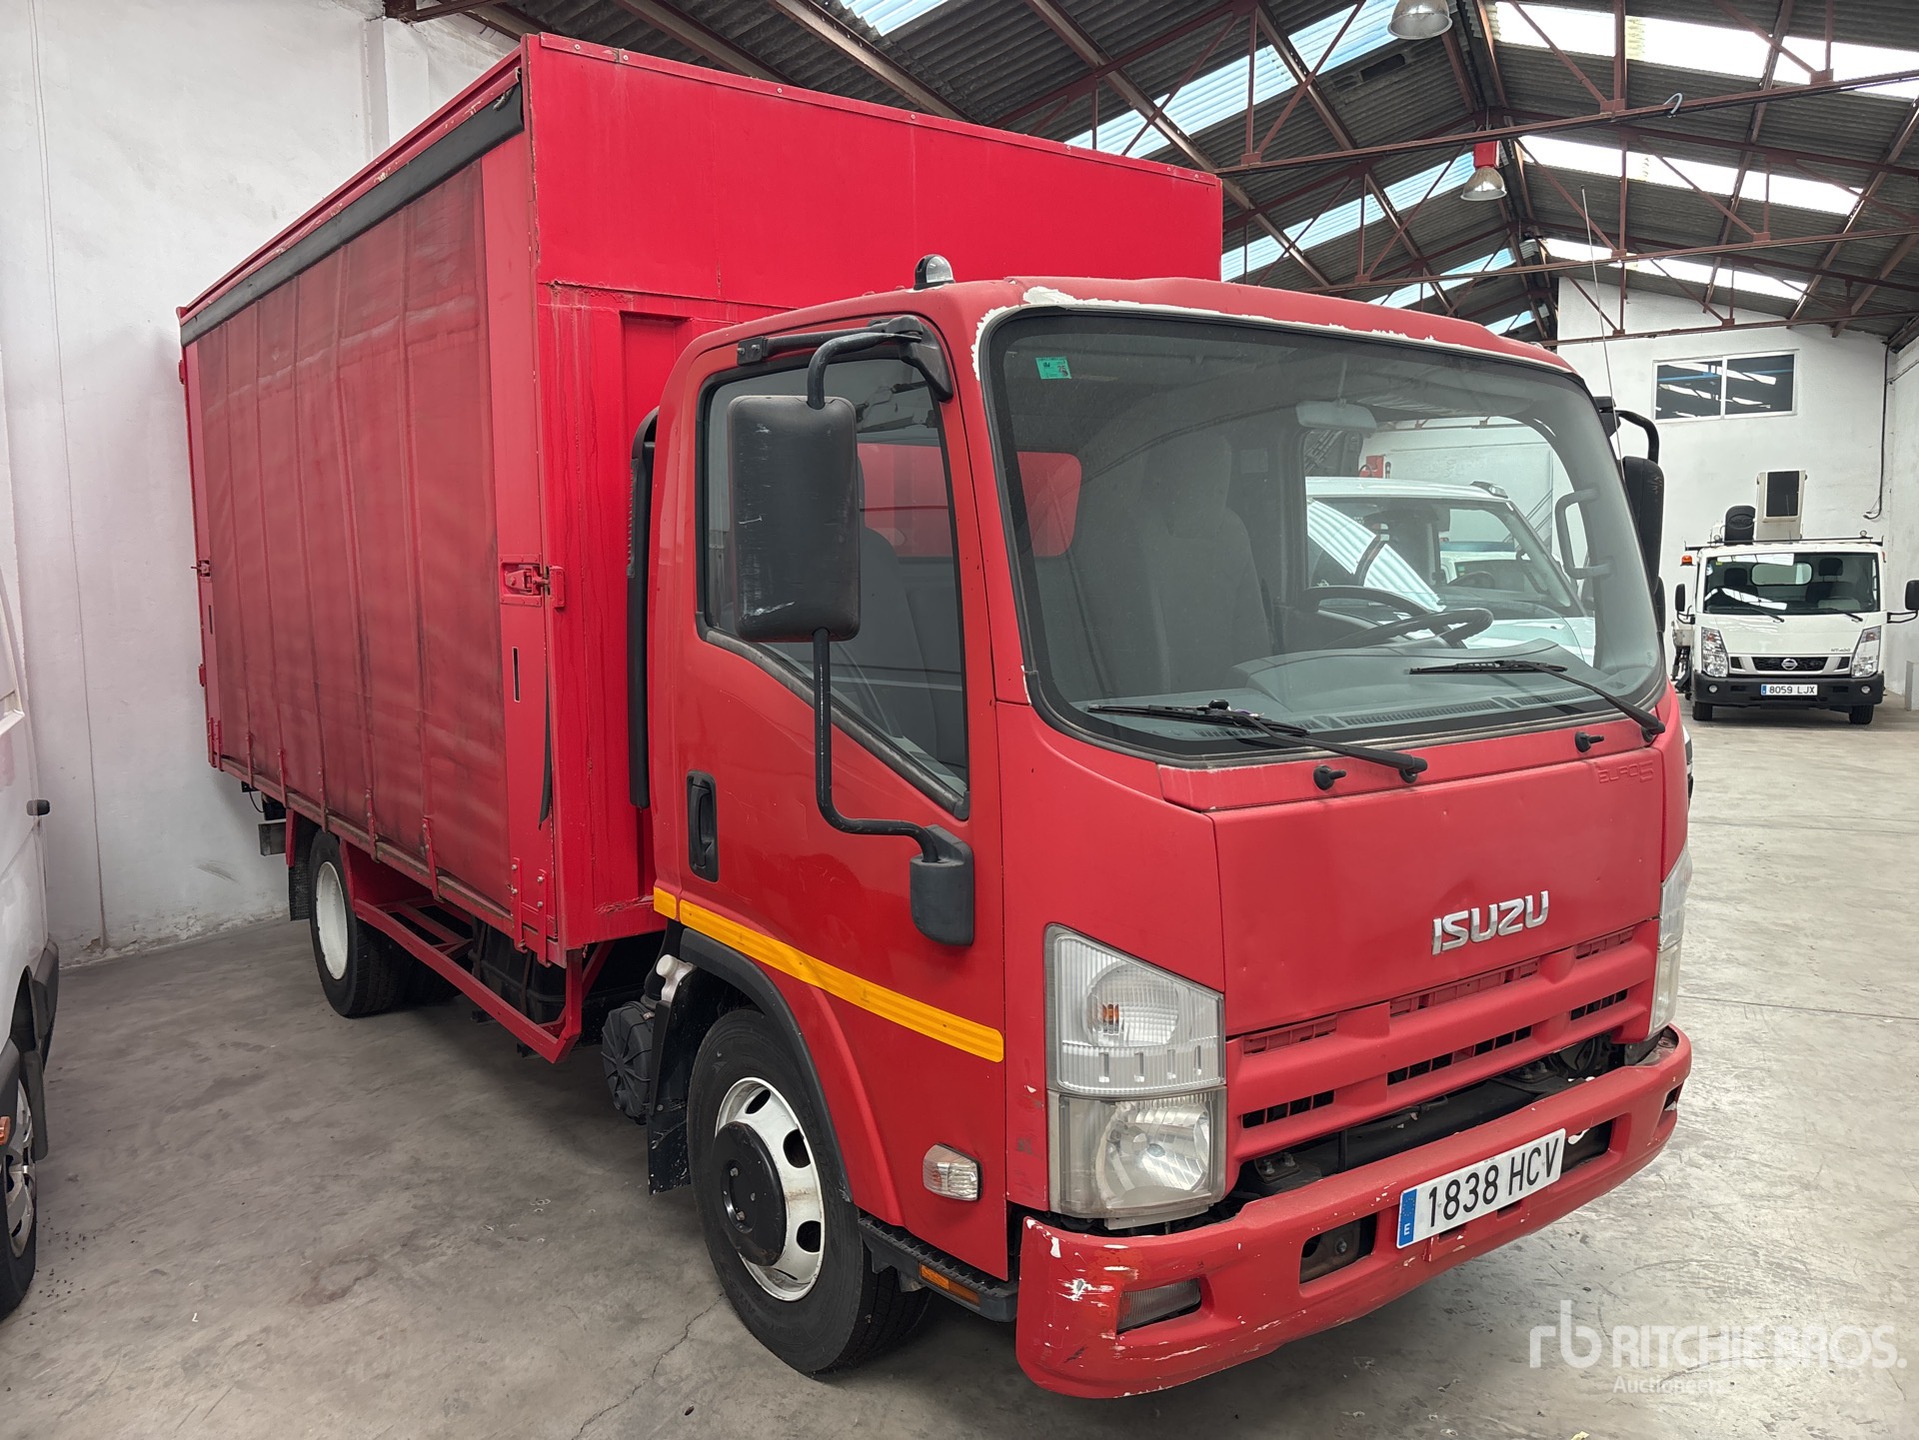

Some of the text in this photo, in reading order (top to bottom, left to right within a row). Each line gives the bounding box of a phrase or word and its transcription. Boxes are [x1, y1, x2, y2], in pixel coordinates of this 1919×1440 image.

[1769, 685, 1815, 694] 8059 LJX
[1432, 890, 1549, 956] ISUZU
[1429, 1137, 1559, 1228] 1838 HCV
[1403, 1222, 1411, 1236] E
